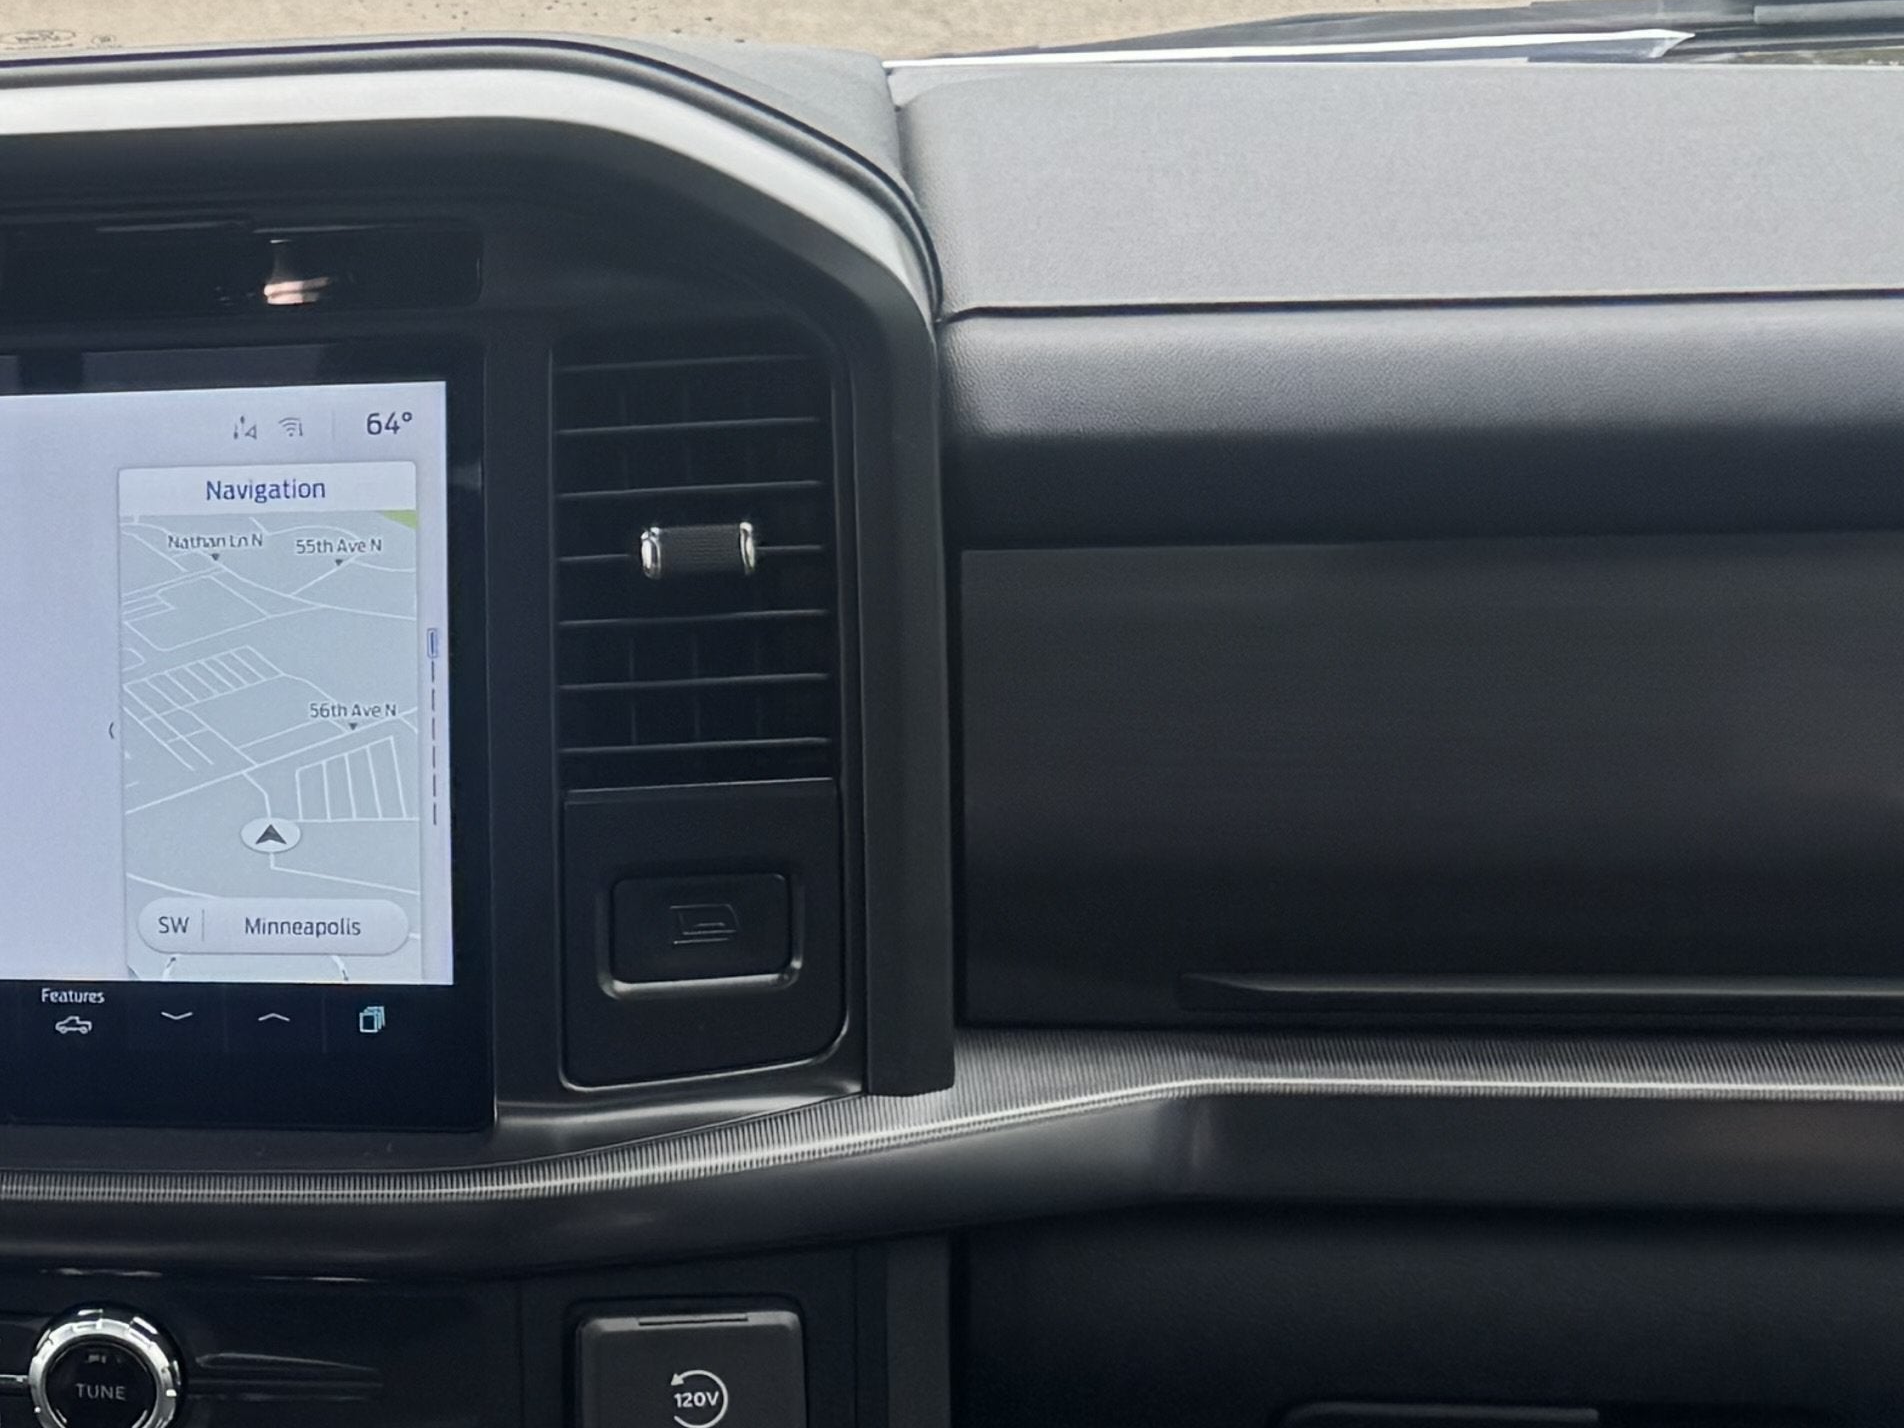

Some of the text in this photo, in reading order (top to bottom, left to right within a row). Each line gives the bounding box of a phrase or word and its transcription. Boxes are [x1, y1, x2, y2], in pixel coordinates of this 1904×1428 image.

[206, 475, 327, 503] Navigation
[167, 534, 226, 549] Nathan
[252, 534, 263, 547] N
[296, 539, 382, 554] 55th Ave N
[310, 703, 397, 718] 56th Ave N
[158, 916, 361, 941] SW Minneapolis
[41, 989, 105, 1004] Features
[75, 1383, 126, 1401] TUNE
[674, 1390, 720, 1408] 120V
